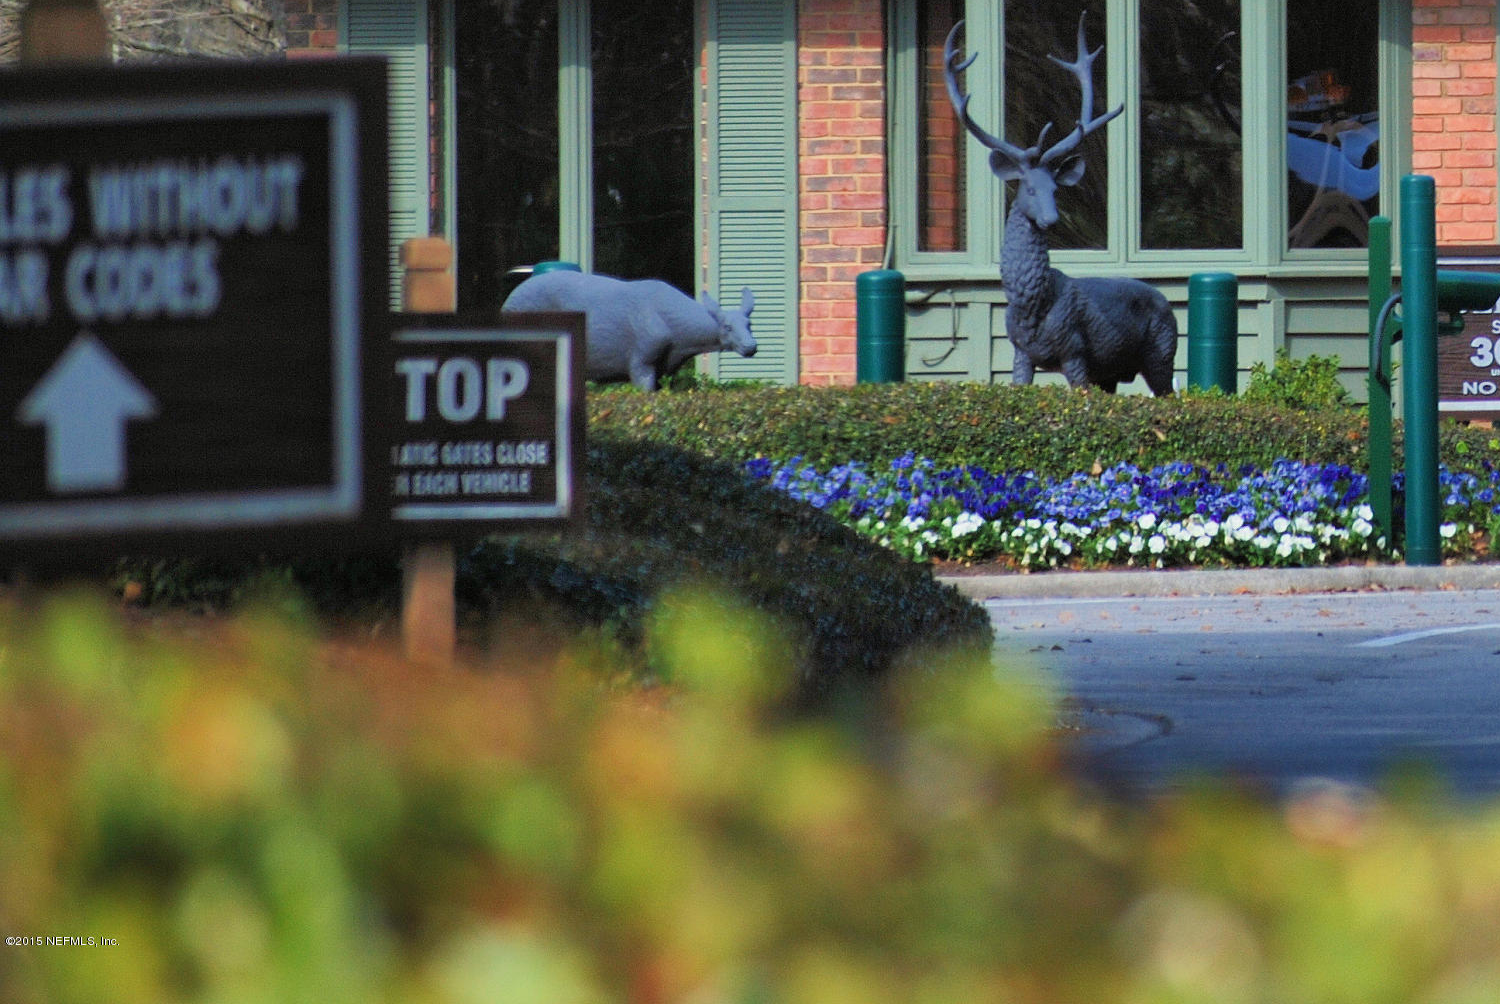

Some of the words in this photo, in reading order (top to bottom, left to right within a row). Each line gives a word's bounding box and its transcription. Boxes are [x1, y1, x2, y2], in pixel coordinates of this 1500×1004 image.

[88, 156, 301, 236] WITHOUT
[65, 241, 222, 319] CODES
[394, 356, 530, 422] TOP
[1462, 380, 1497, 395] NO
[441, 441, 493, 465] GATES
[496, 440, 550, 465] CLOSE
[412, 471, 460, 495] EACH
[461, 470, 533, 494] VEHICLE
